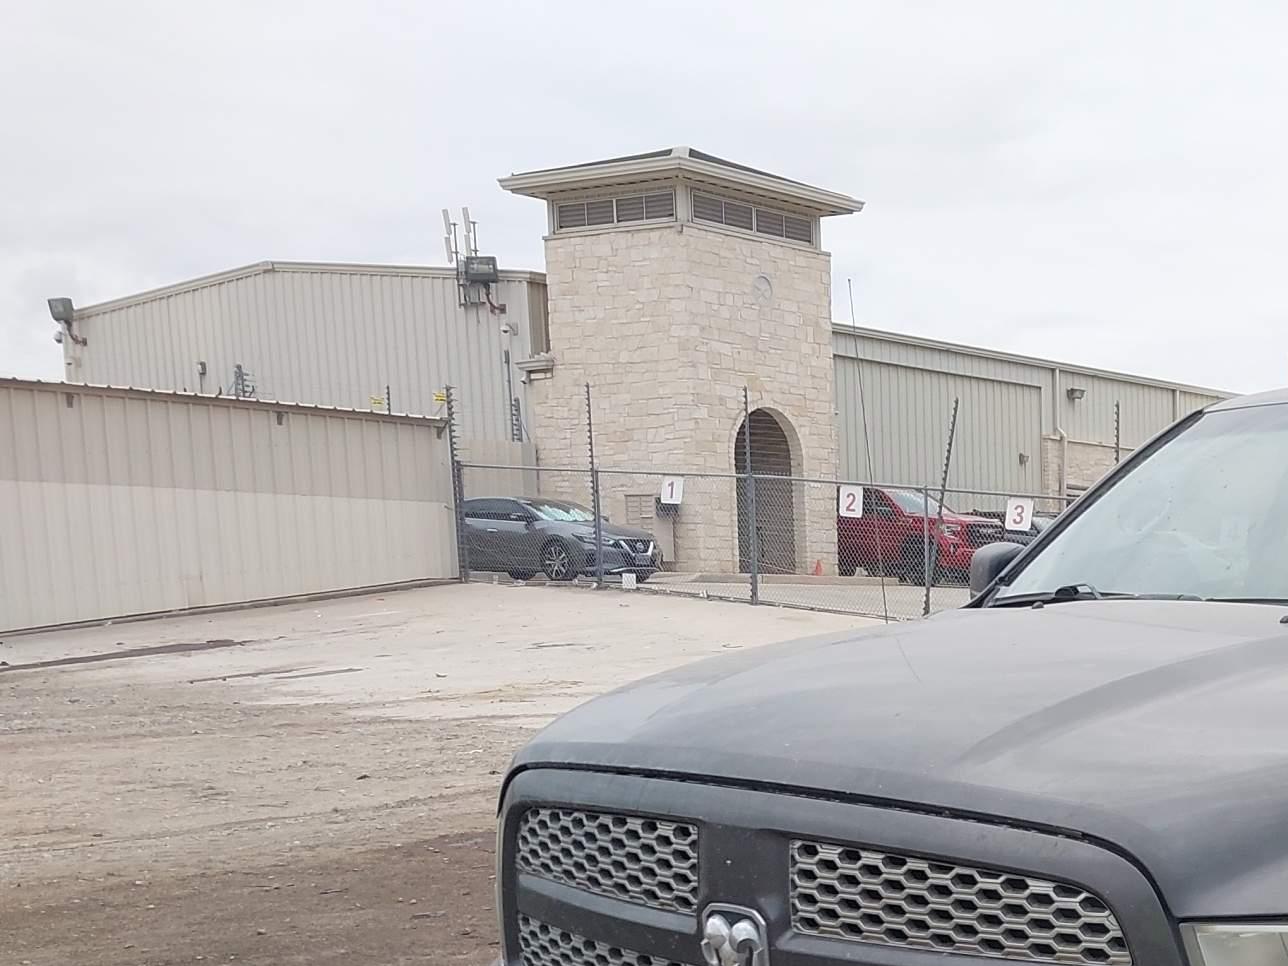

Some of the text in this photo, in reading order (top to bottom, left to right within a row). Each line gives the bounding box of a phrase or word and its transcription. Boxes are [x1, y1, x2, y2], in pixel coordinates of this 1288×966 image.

[667, 480, 675, 499] 1
[845, 492, 856, 512] 2
[1012, 504, 1025, 525] 3
